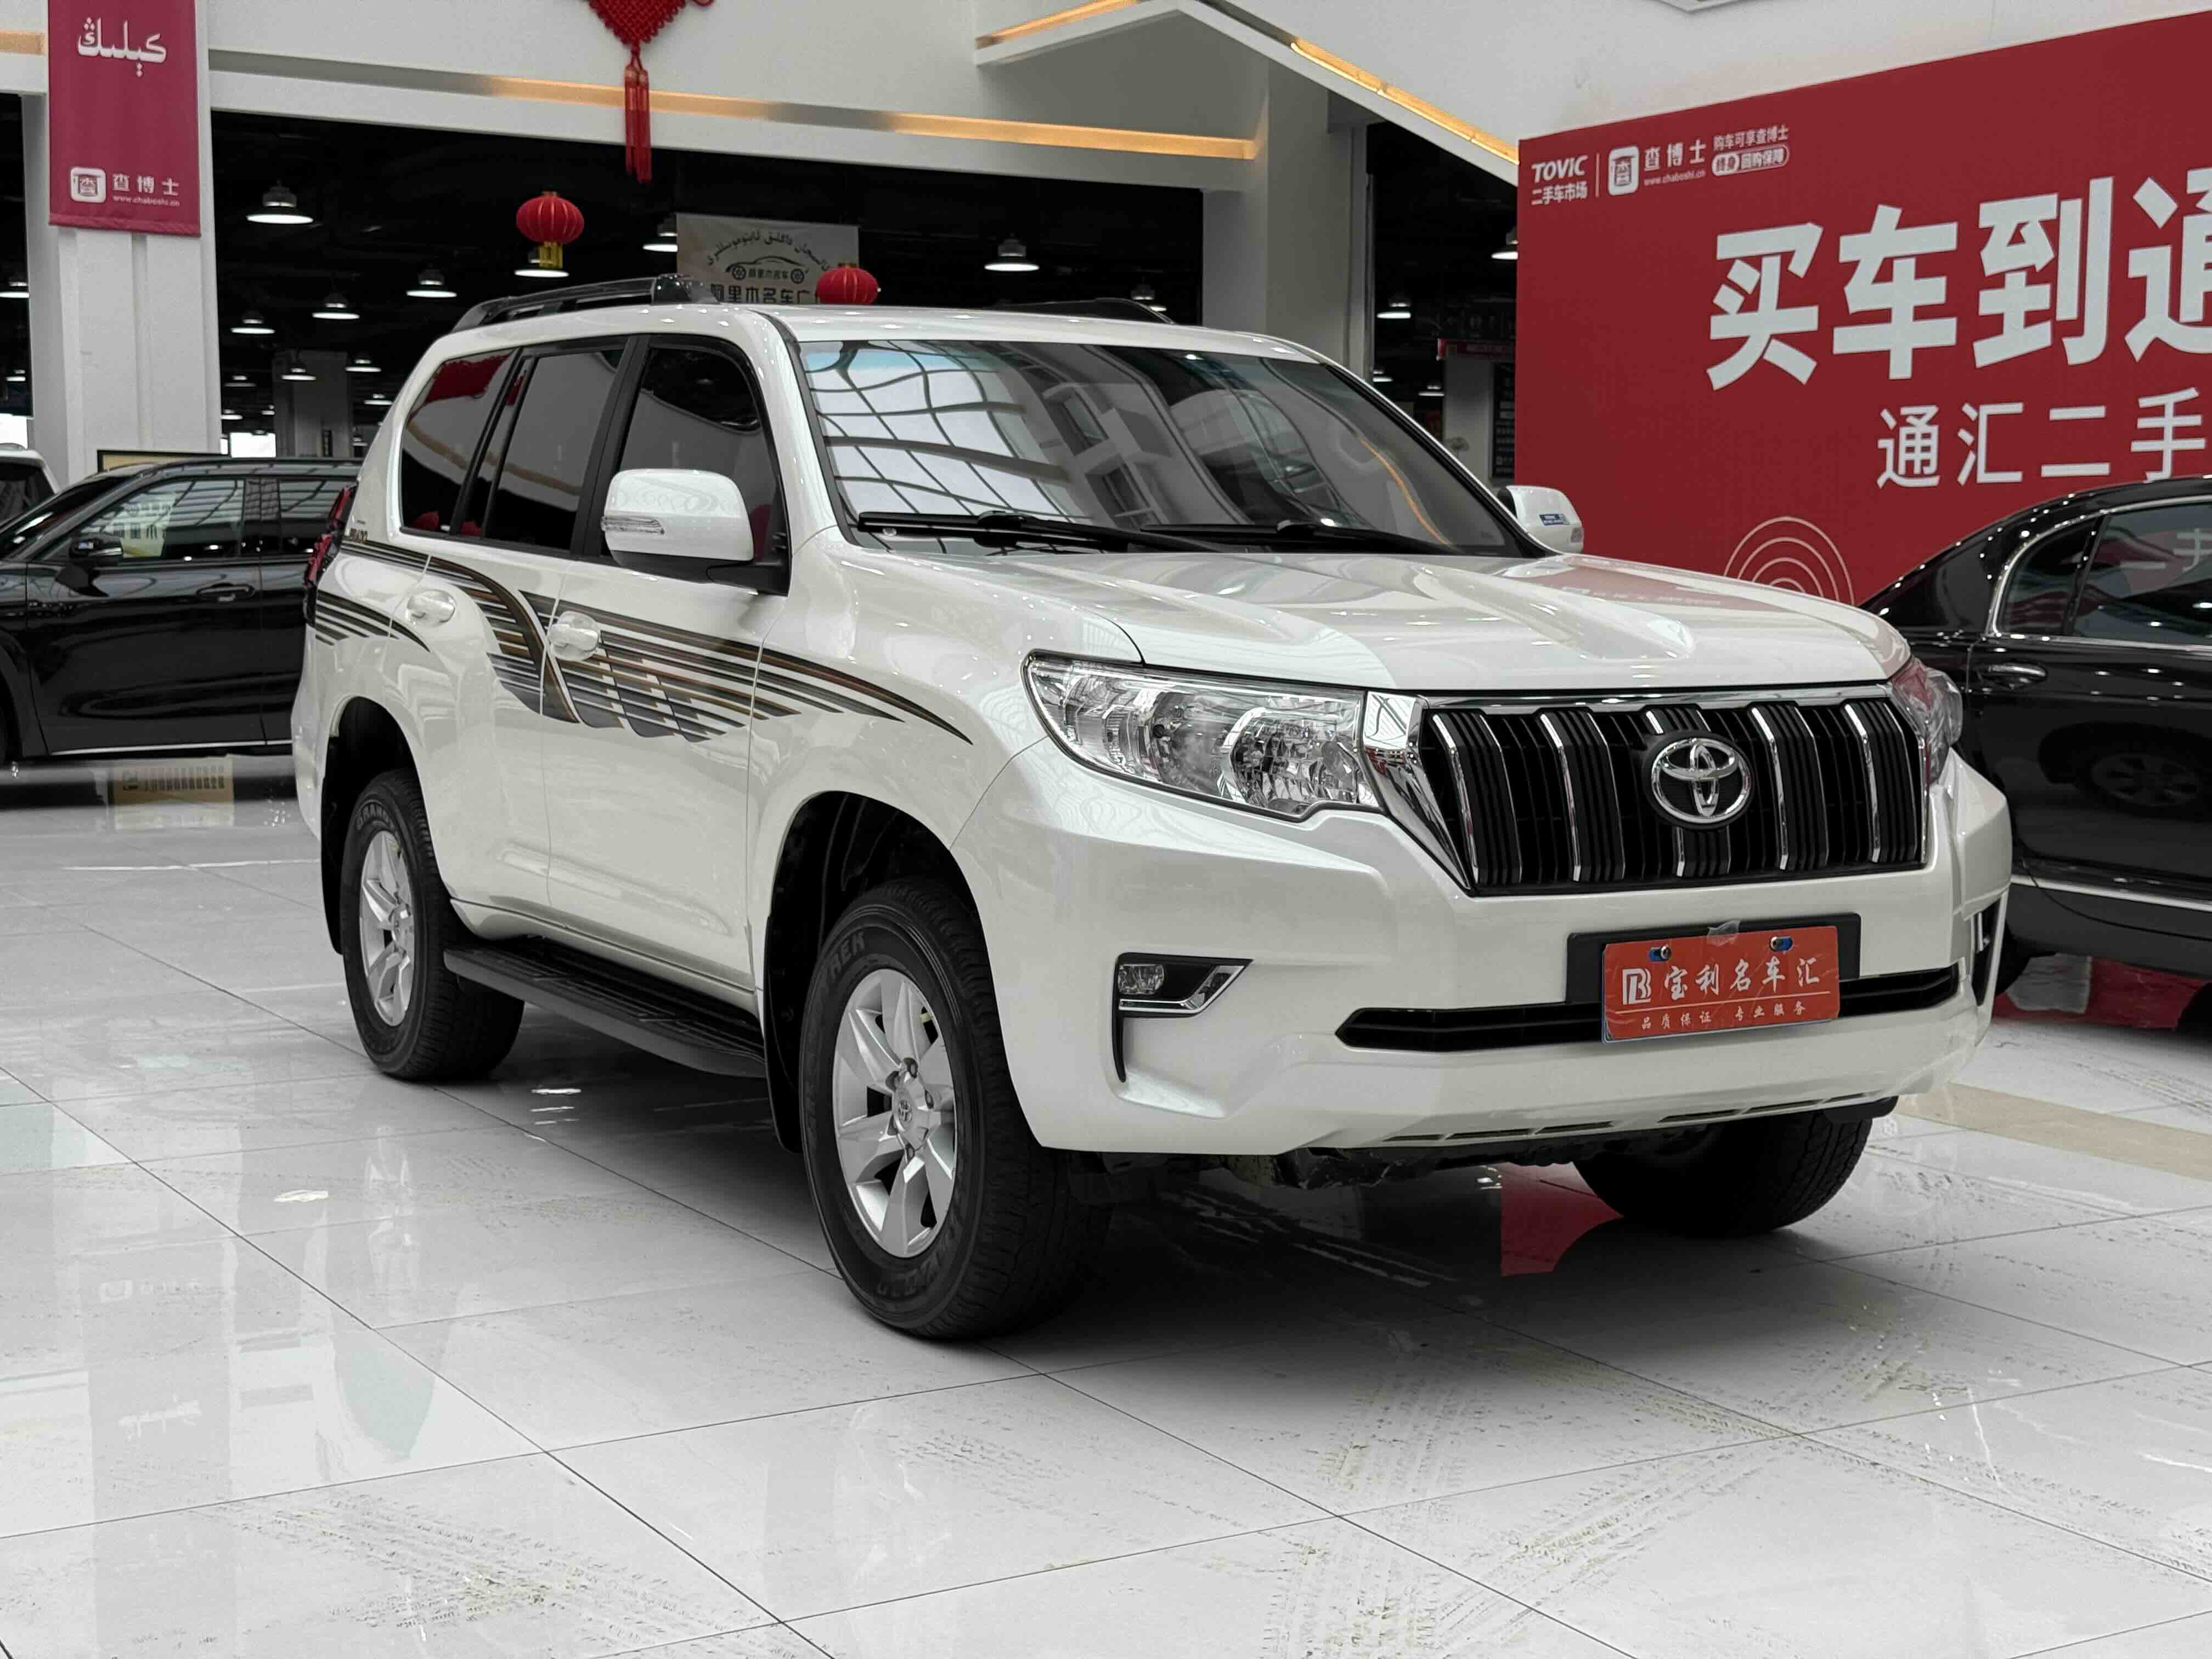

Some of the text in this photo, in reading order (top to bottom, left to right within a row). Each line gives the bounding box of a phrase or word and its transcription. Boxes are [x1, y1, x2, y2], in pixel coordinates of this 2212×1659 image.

[1531, 155, 1588, 183] TOVIC
[1644, 138, 1707, 172] 查博士
[1531, 181, 1588, 205] 二手车市场
[1644, 170, 1706, 186] www.chaboshi.cn
[1706, 167, 2212, 390] 买车到通
[711, 284, 819, 304] 阿里木名车广
[1877, 387, 2206, 489] 通汇二手
[1664, 956, 1820, 1001] 宝利名车汇
[1641, 1000, 1807, 1030] 品质保证 专业服务
